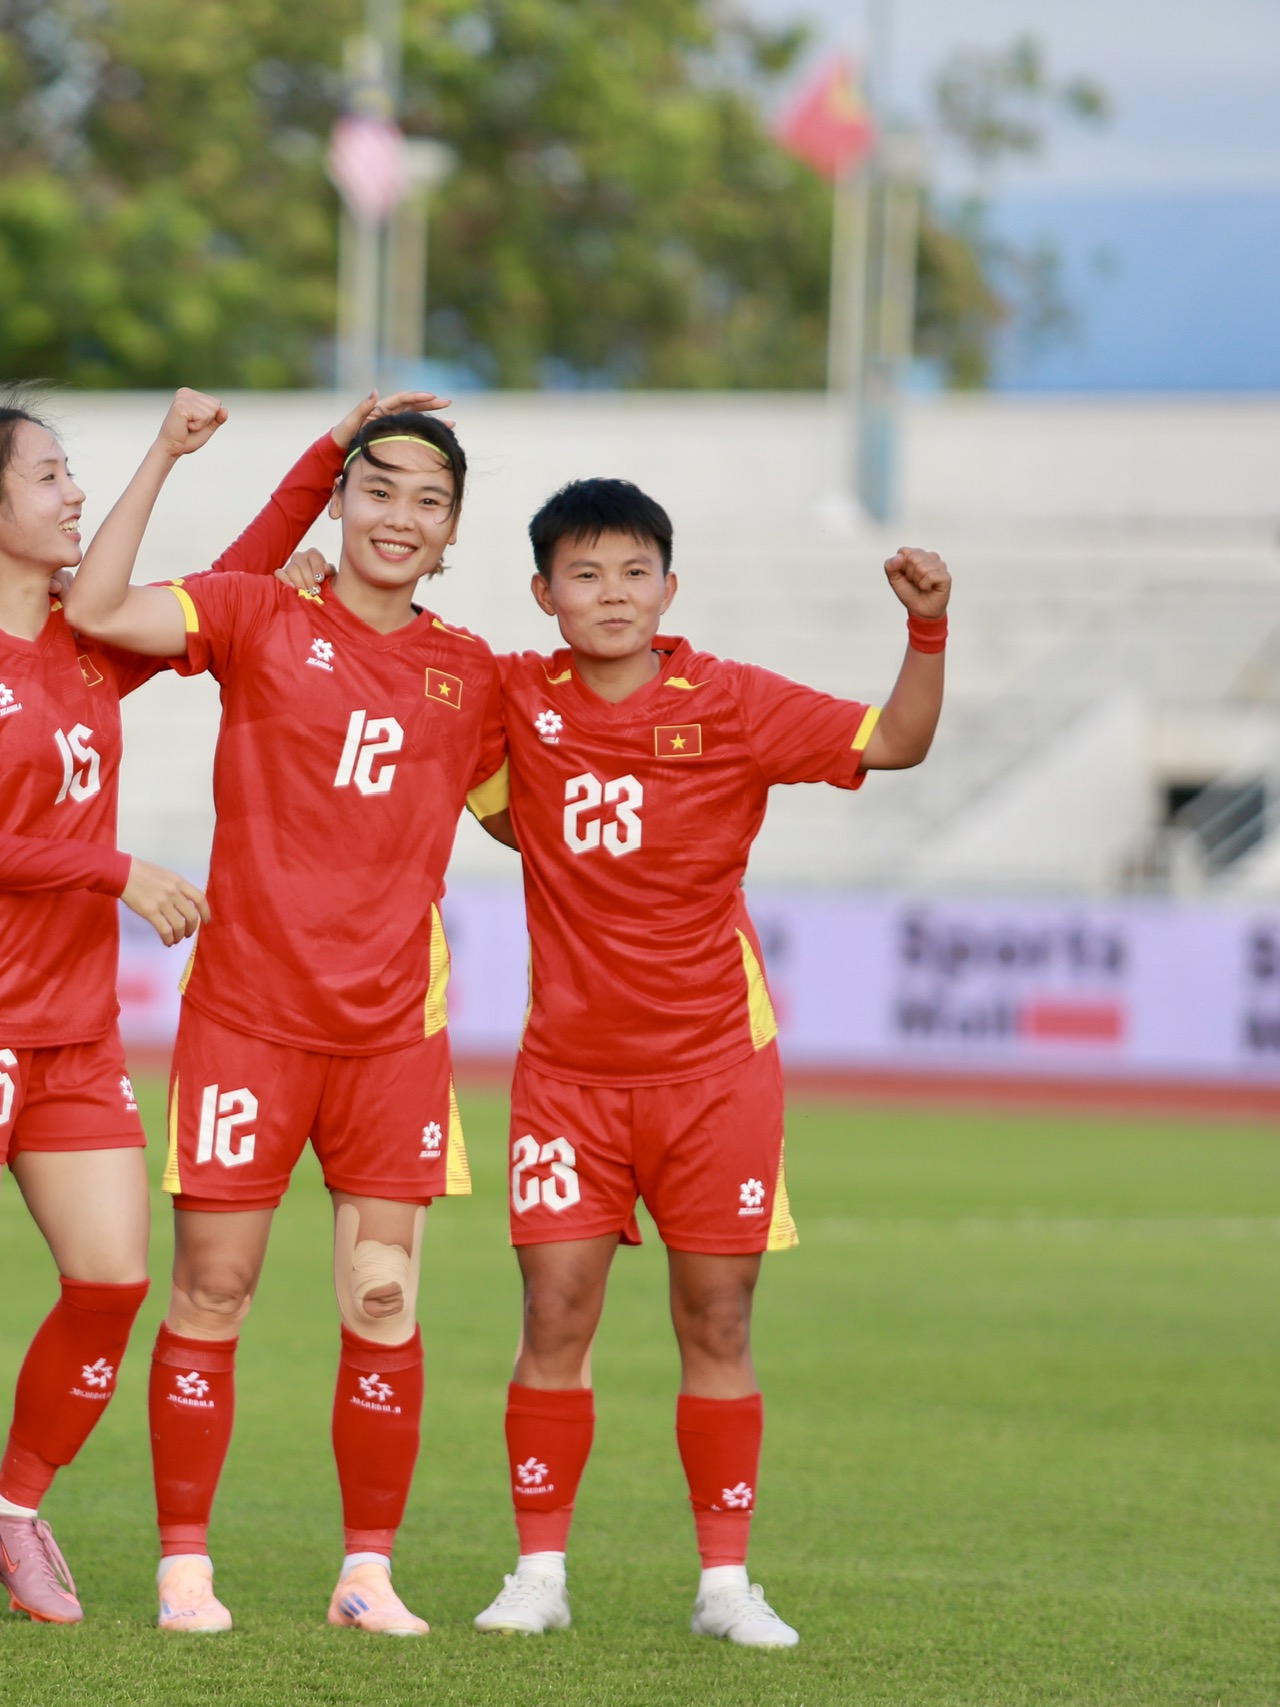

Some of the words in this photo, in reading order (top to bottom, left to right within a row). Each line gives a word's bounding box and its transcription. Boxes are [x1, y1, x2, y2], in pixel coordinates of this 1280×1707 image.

[54, 722, 101, 806] 15
[333, 709, 404, 796] 12
[563, 772, 644, 857] 23
[196, 1083, 259, 1168] 12
[512, 1134, 581, 1214] 23
